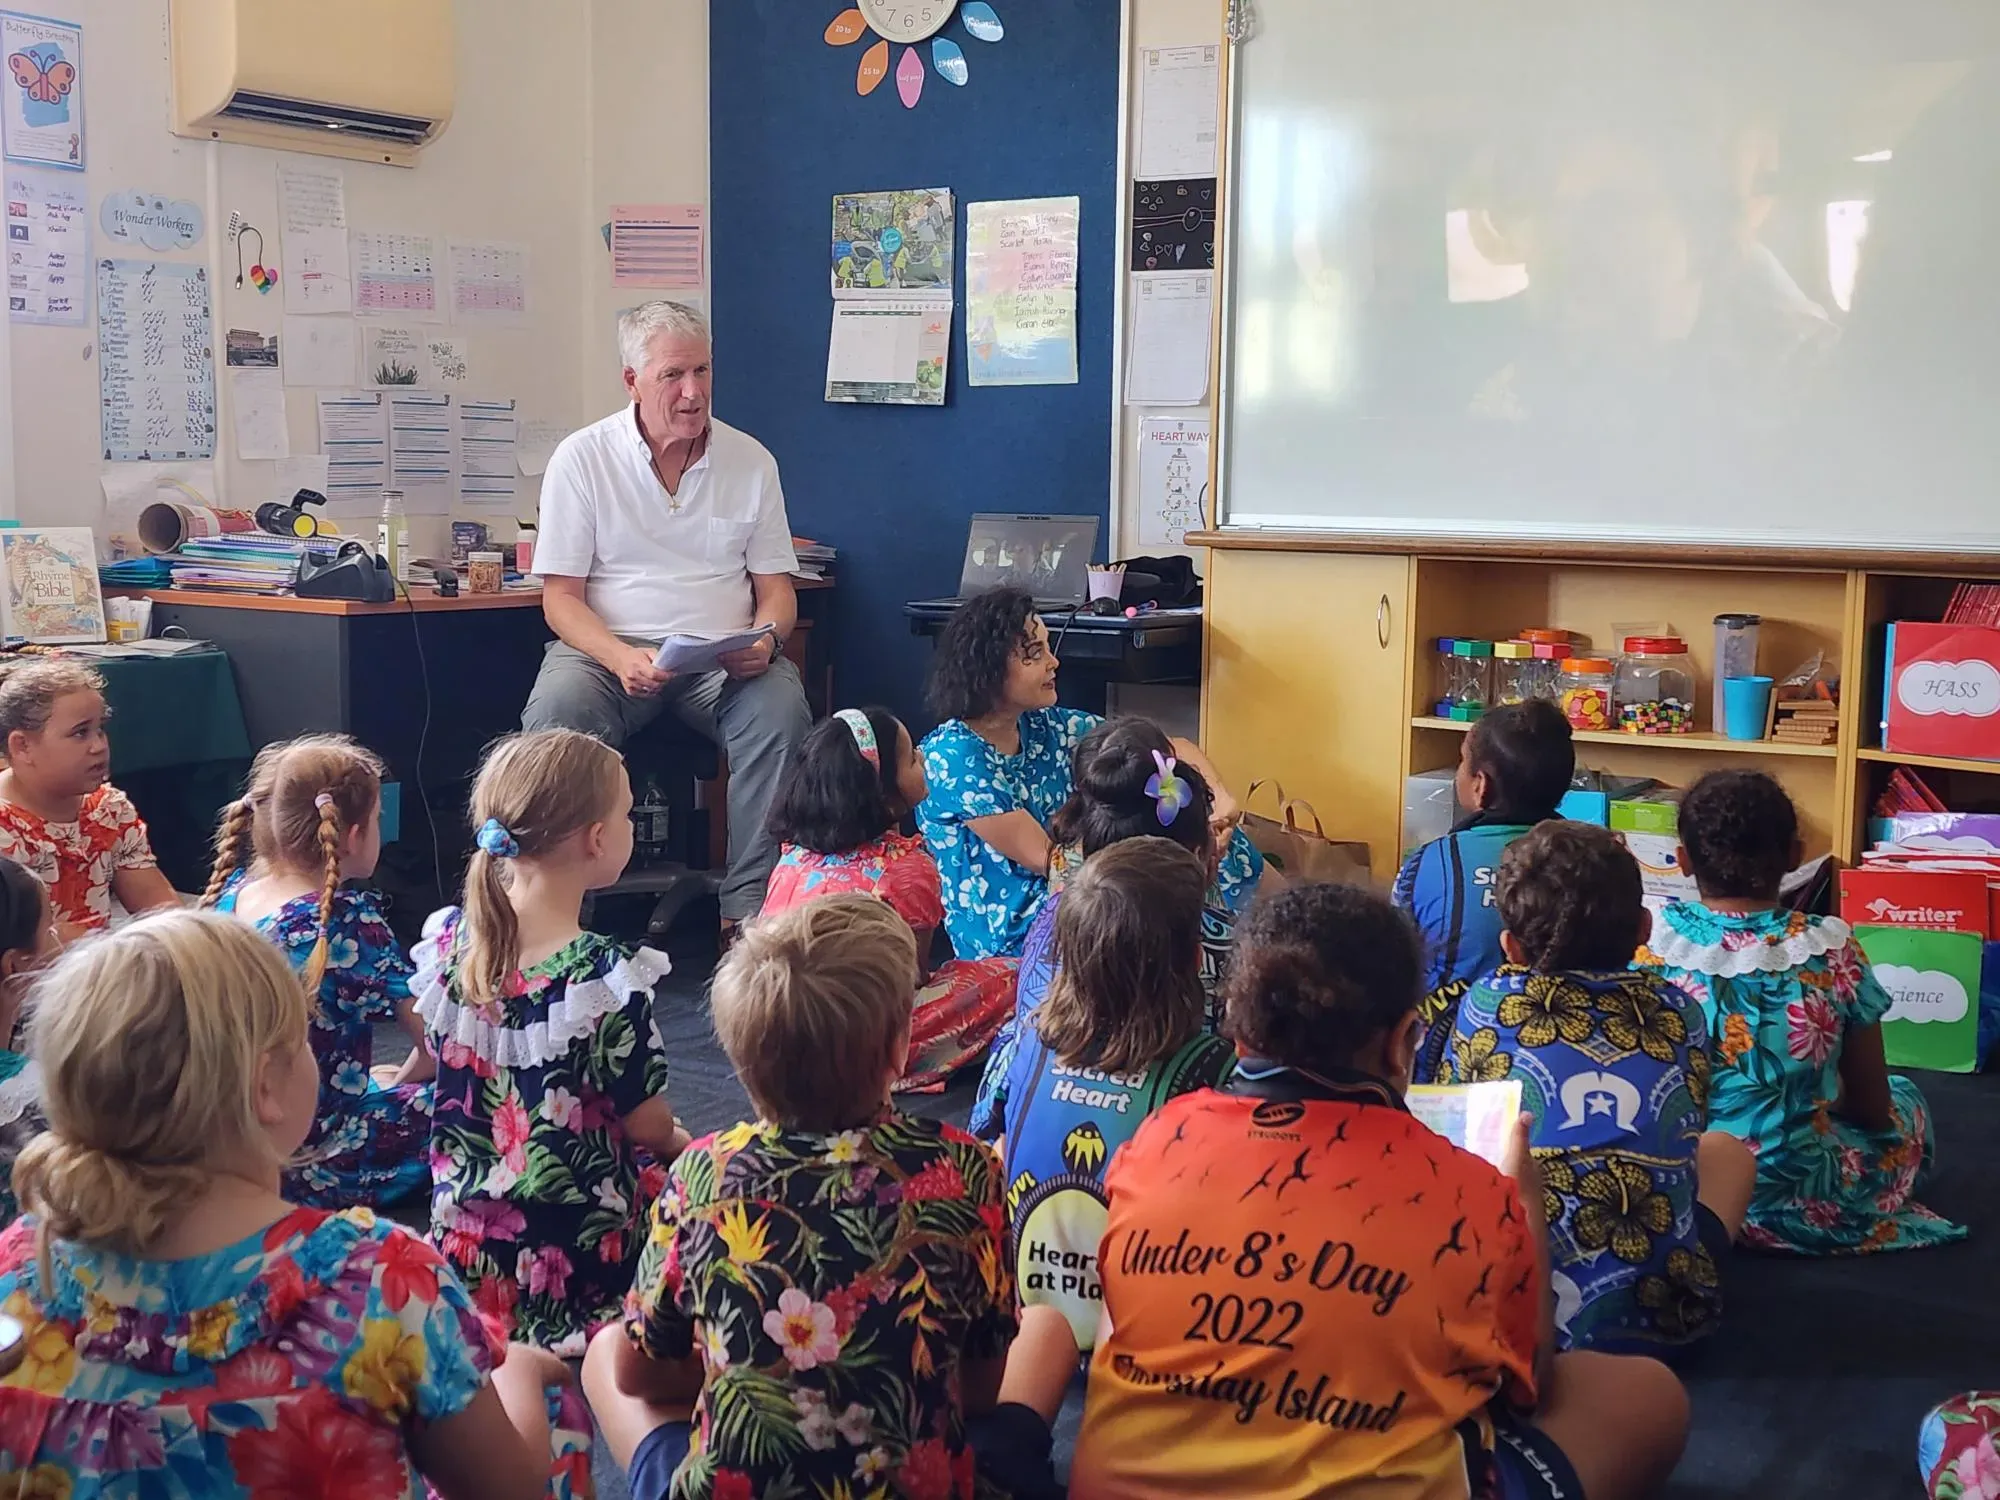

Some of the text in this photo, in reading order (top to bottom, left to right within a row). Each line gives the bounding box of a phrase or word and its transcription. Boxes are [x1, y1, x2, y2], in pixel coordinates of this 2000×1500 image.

[886, 9, 896, 22] 7
[904, 14, 914, 27] 6
[921, 8, 931, 21] 5
[113, 209, 194, 234] Wonder Workers
[1151, 432, 1209, 442] HEART WAY
[37, 581, 71, 598] Bible
[1922, 679, 1981, 699] HASS
[1887, 906, 1957, 923] writer
[1050, 1079, 1131, 1114] Heart
[1026, 1269, 1055, 1291] at
[1120, 1228, 1414, 1317] Under 8's Day
[1184, 1293, 1304, 1352] 2022
[1275, 1369, 1406, 1433] Island
